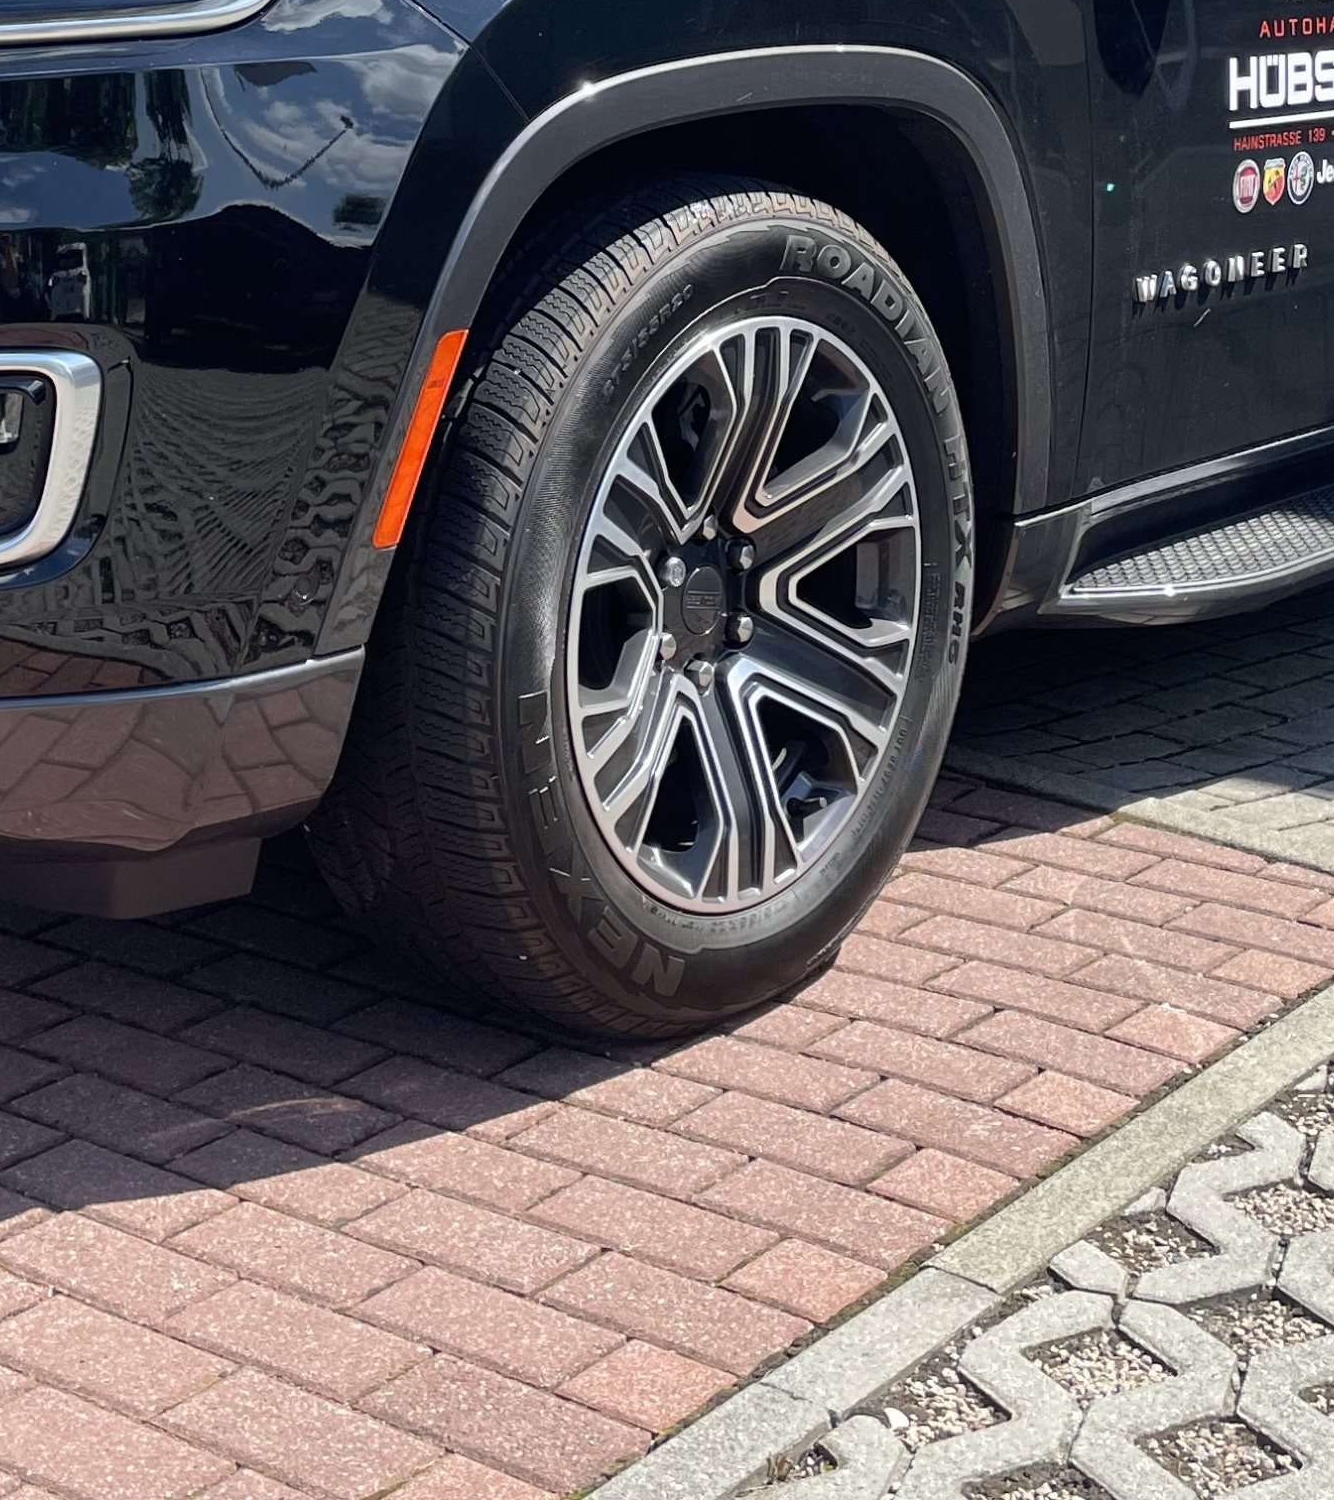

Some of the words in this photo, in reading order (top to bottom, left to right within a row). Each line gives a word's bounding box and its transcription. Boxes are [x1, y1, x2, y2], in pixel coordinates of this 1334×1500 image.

[1233, 130, 1303, 152] HAINSTRASSE
[1307, 127, 1326, 143] 139
[780, 234, 955, 418] ROADIAN
[1134, 242, 1311, 304] WAGONEER
[517, 691, 686, 997] NEXEN
